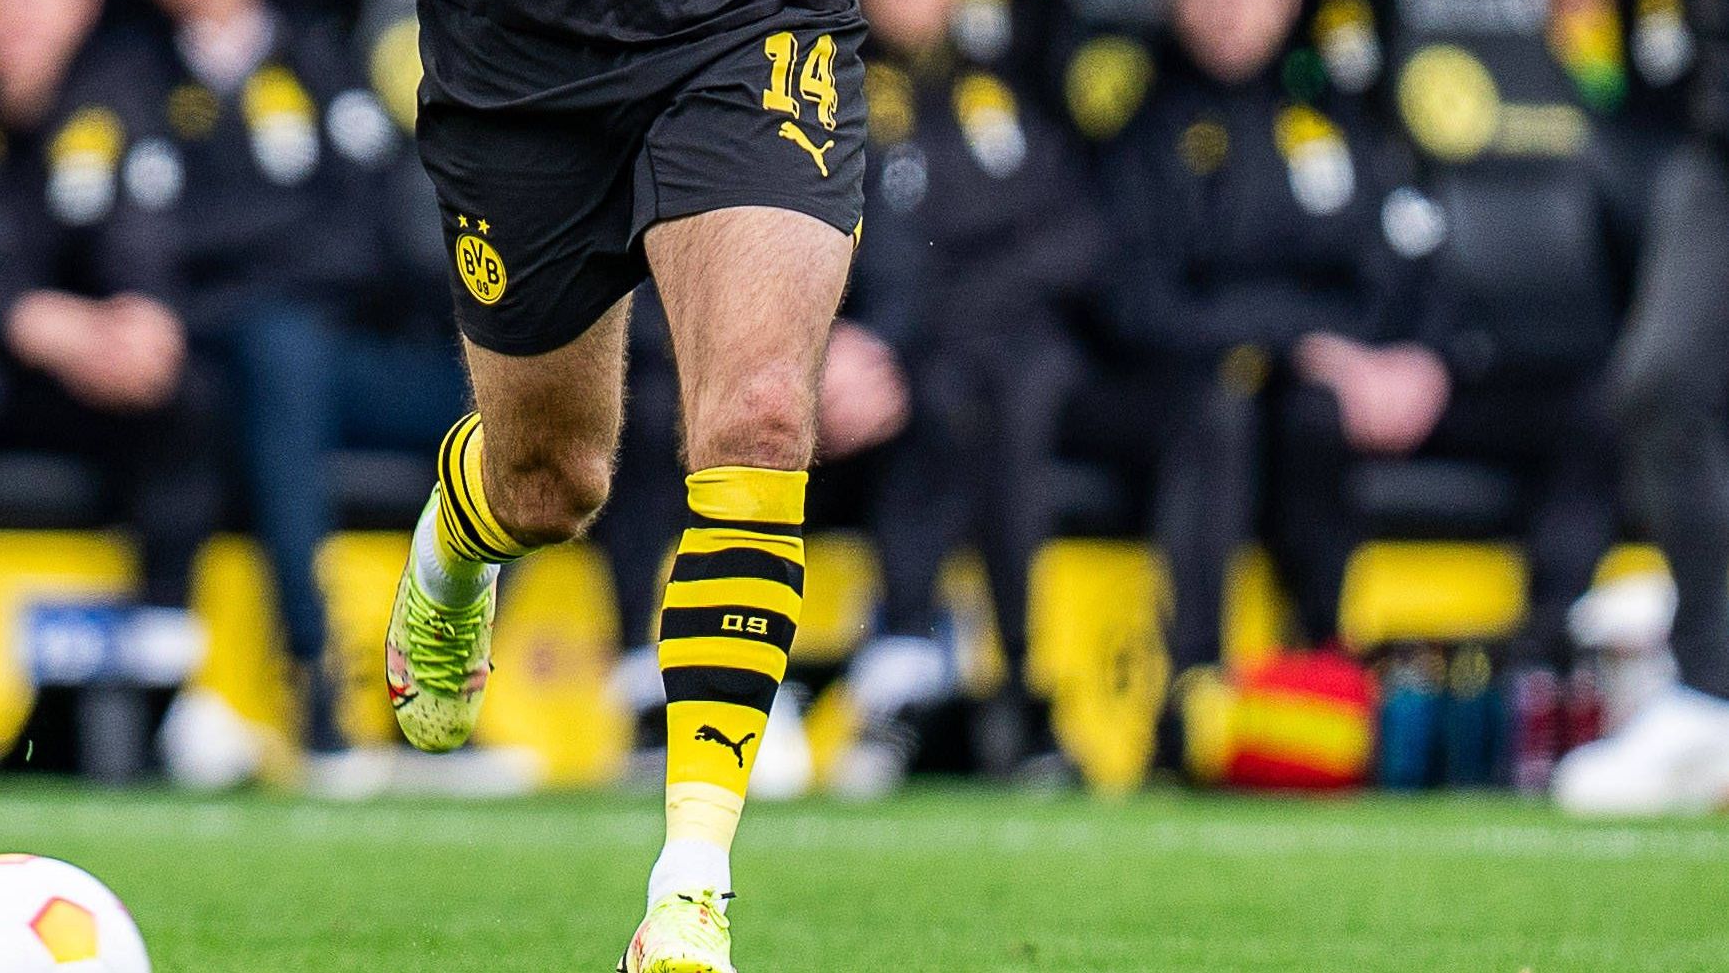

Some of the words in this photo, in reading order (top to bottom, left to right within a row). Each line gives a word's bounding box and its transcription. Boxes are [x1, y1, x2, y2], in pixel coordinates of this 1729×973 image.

[762, 31, 838, 131] 14
[462, 239, 500, 285] BVB
[476, 279, 490, 296] 09
[721, 614, 768, 635] 09
